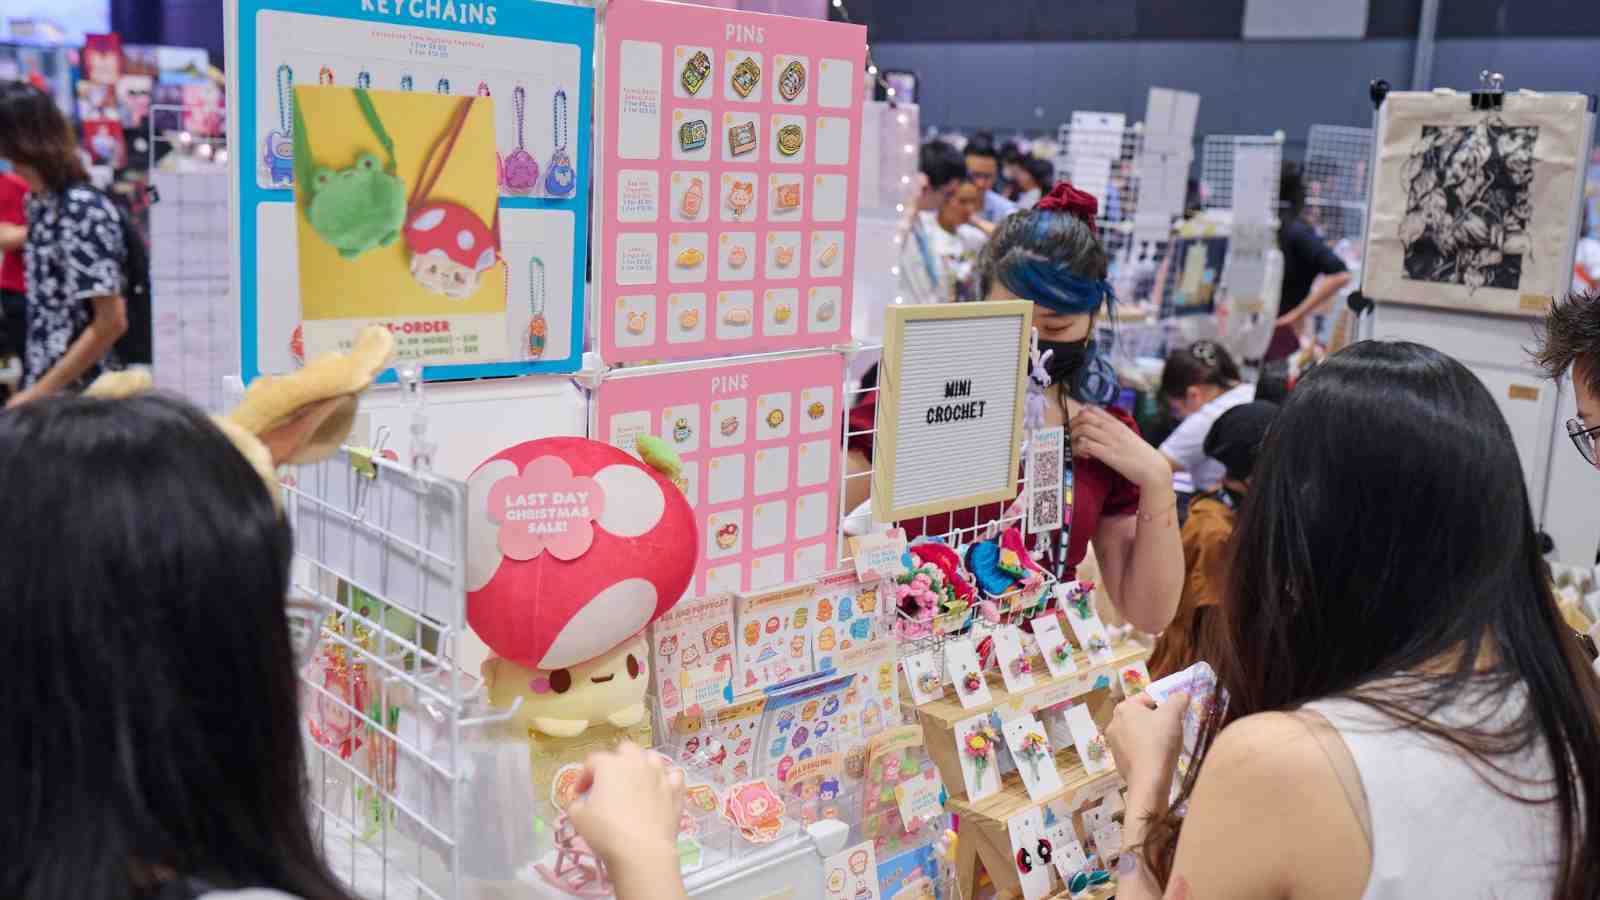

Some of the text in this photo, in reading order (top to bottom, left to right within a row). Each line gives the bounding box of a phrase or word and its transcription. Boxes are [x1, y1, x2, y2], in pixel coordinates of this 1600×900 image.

[361, 0, 497, 25] KEYCHAINS
[725, 23, 766, 45] PINS
[711, 374, 750, 393] PINS
[944, 379, 971, 398] MINI
[927, 400, 986, 424] CROCHET
[505, 491, 589, 508] LAST DAY
[505, 506, 591, 520] CHRISTMAS
[528, 520, 568, 533] SALE!
